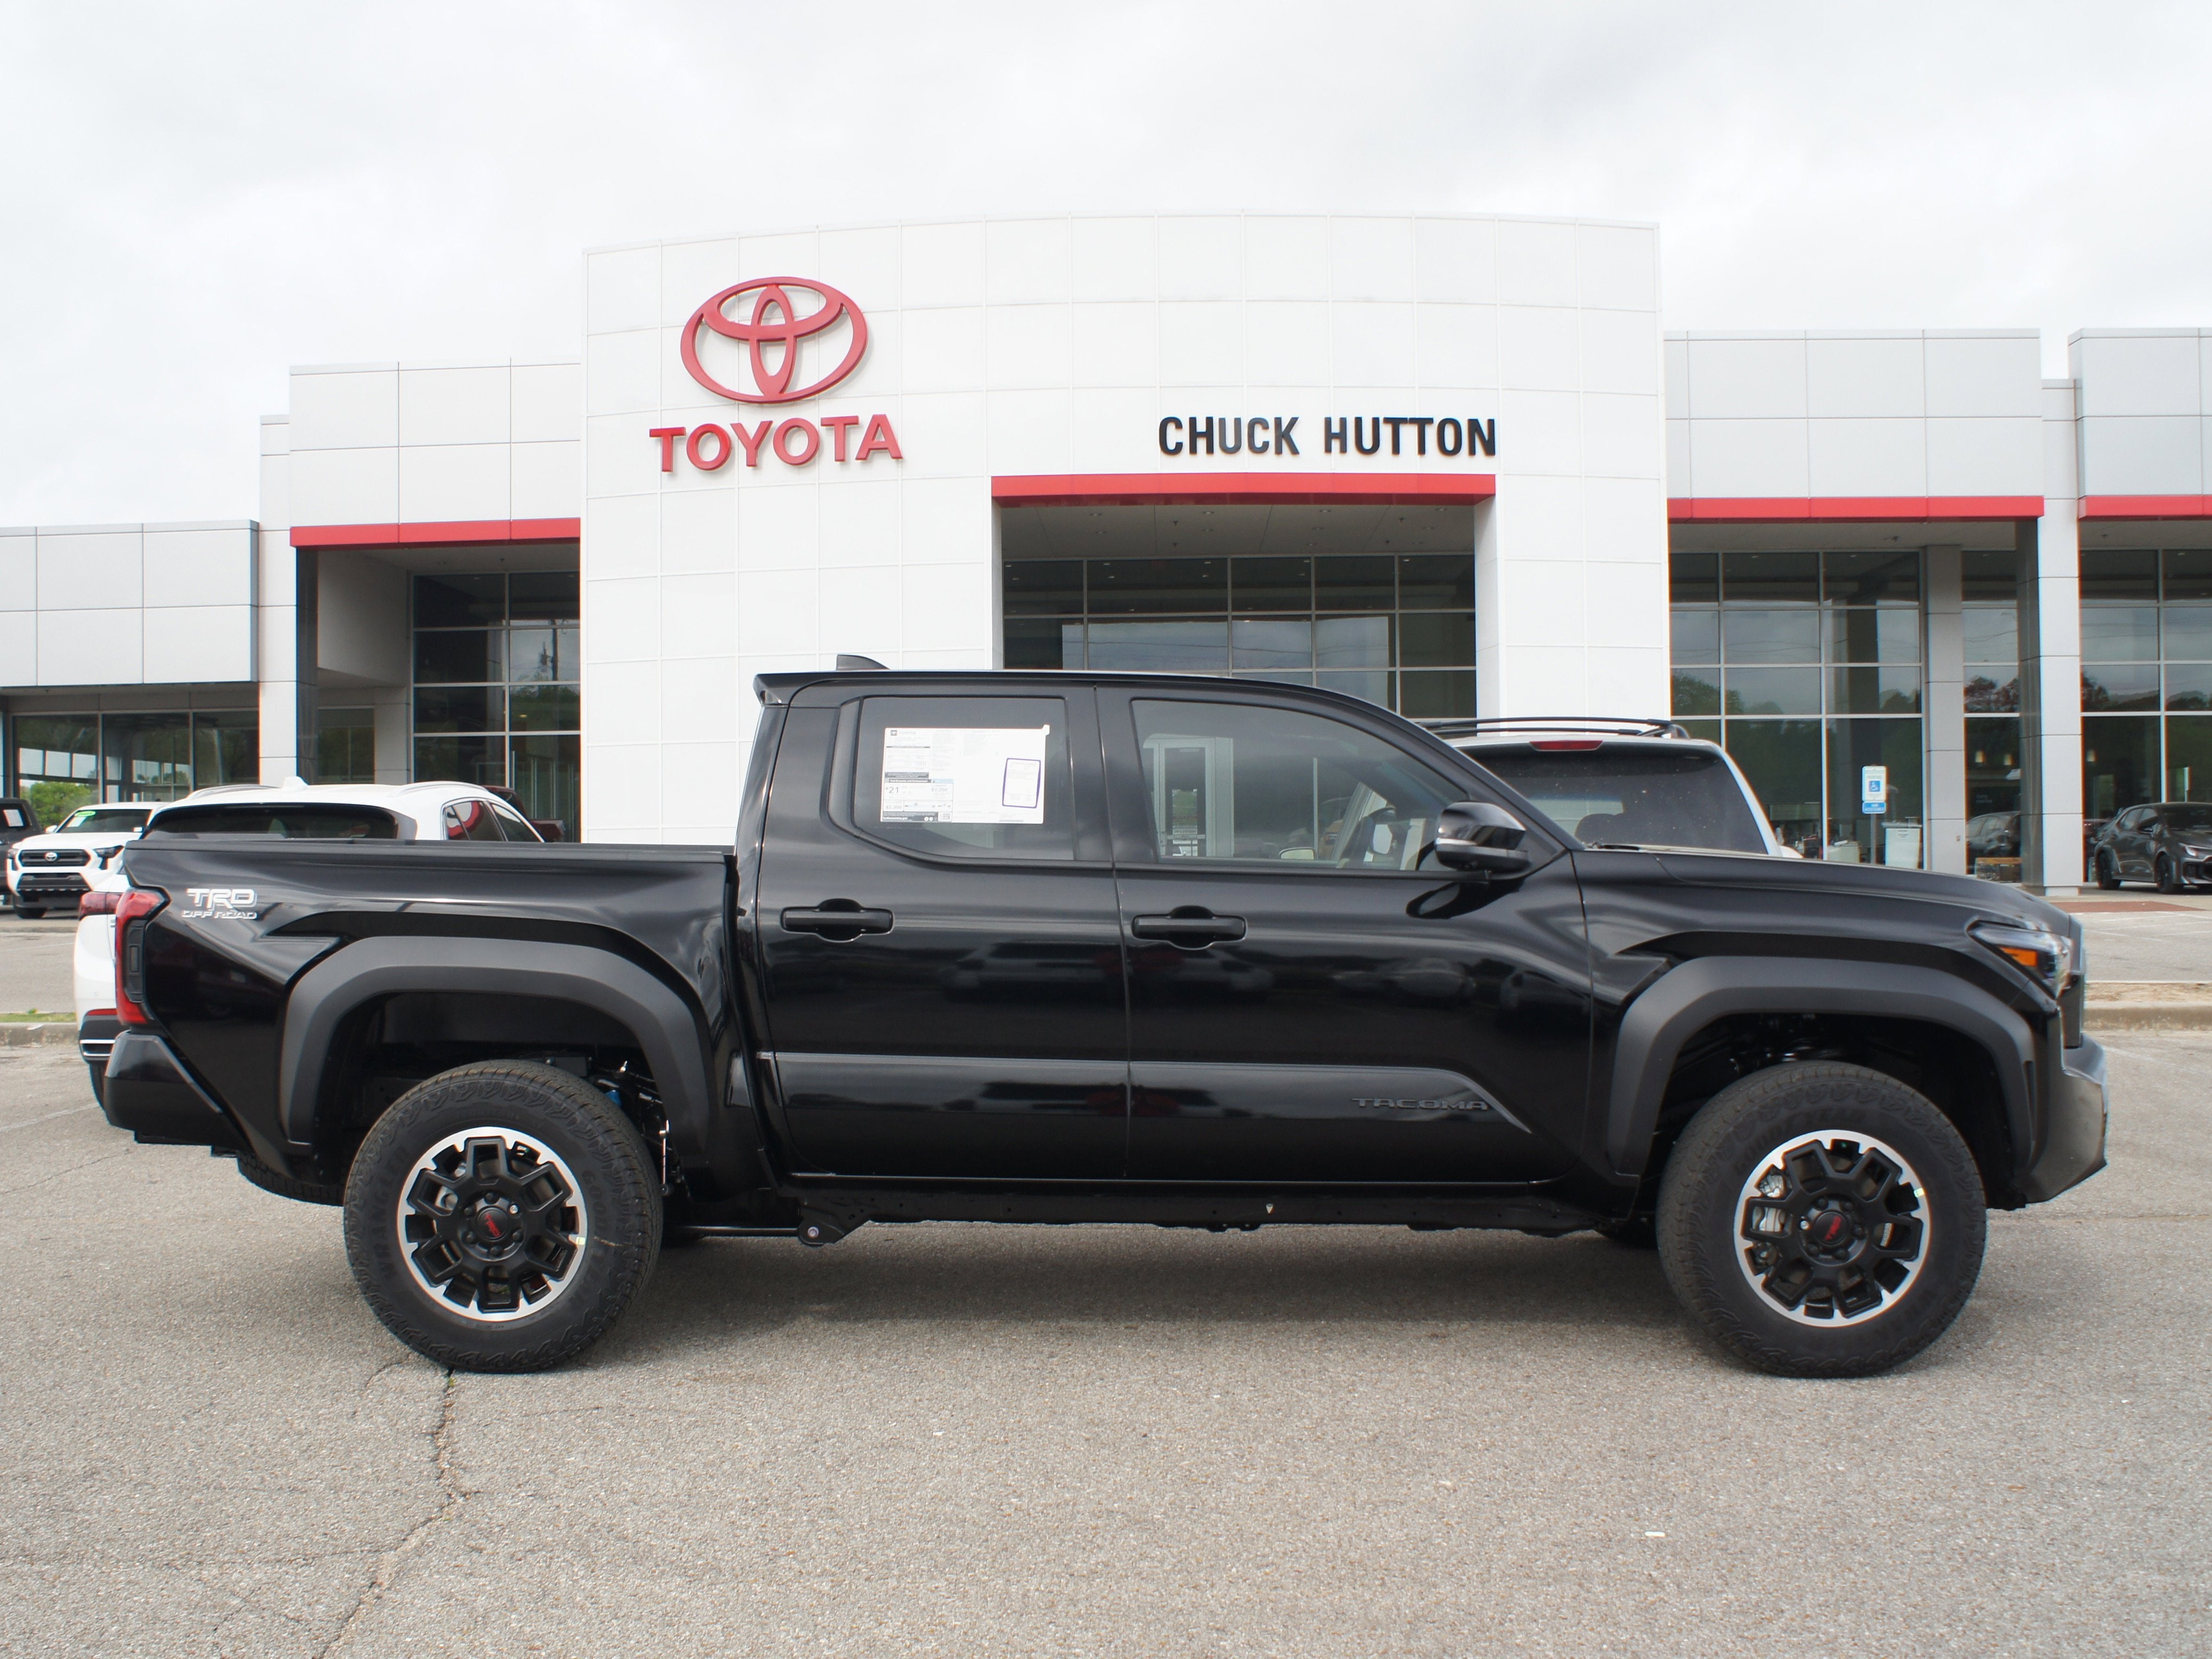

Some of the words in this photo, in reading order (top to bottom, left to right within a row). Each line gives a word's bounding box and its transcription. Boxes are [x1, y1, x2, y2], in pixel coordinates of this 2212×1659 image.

[649, 414, 904, 473] TOYOTA
[1158, 416, 1300, 456] CHUCK
[1323, 416, 1496, 456] HUTTON
[185, 888, 257, 912] TRD
[182, 910, 213, 919] OFF
[213, 910, 258, 920] ROAD
[1351, 1097, 1489, 1111] TACOMA
